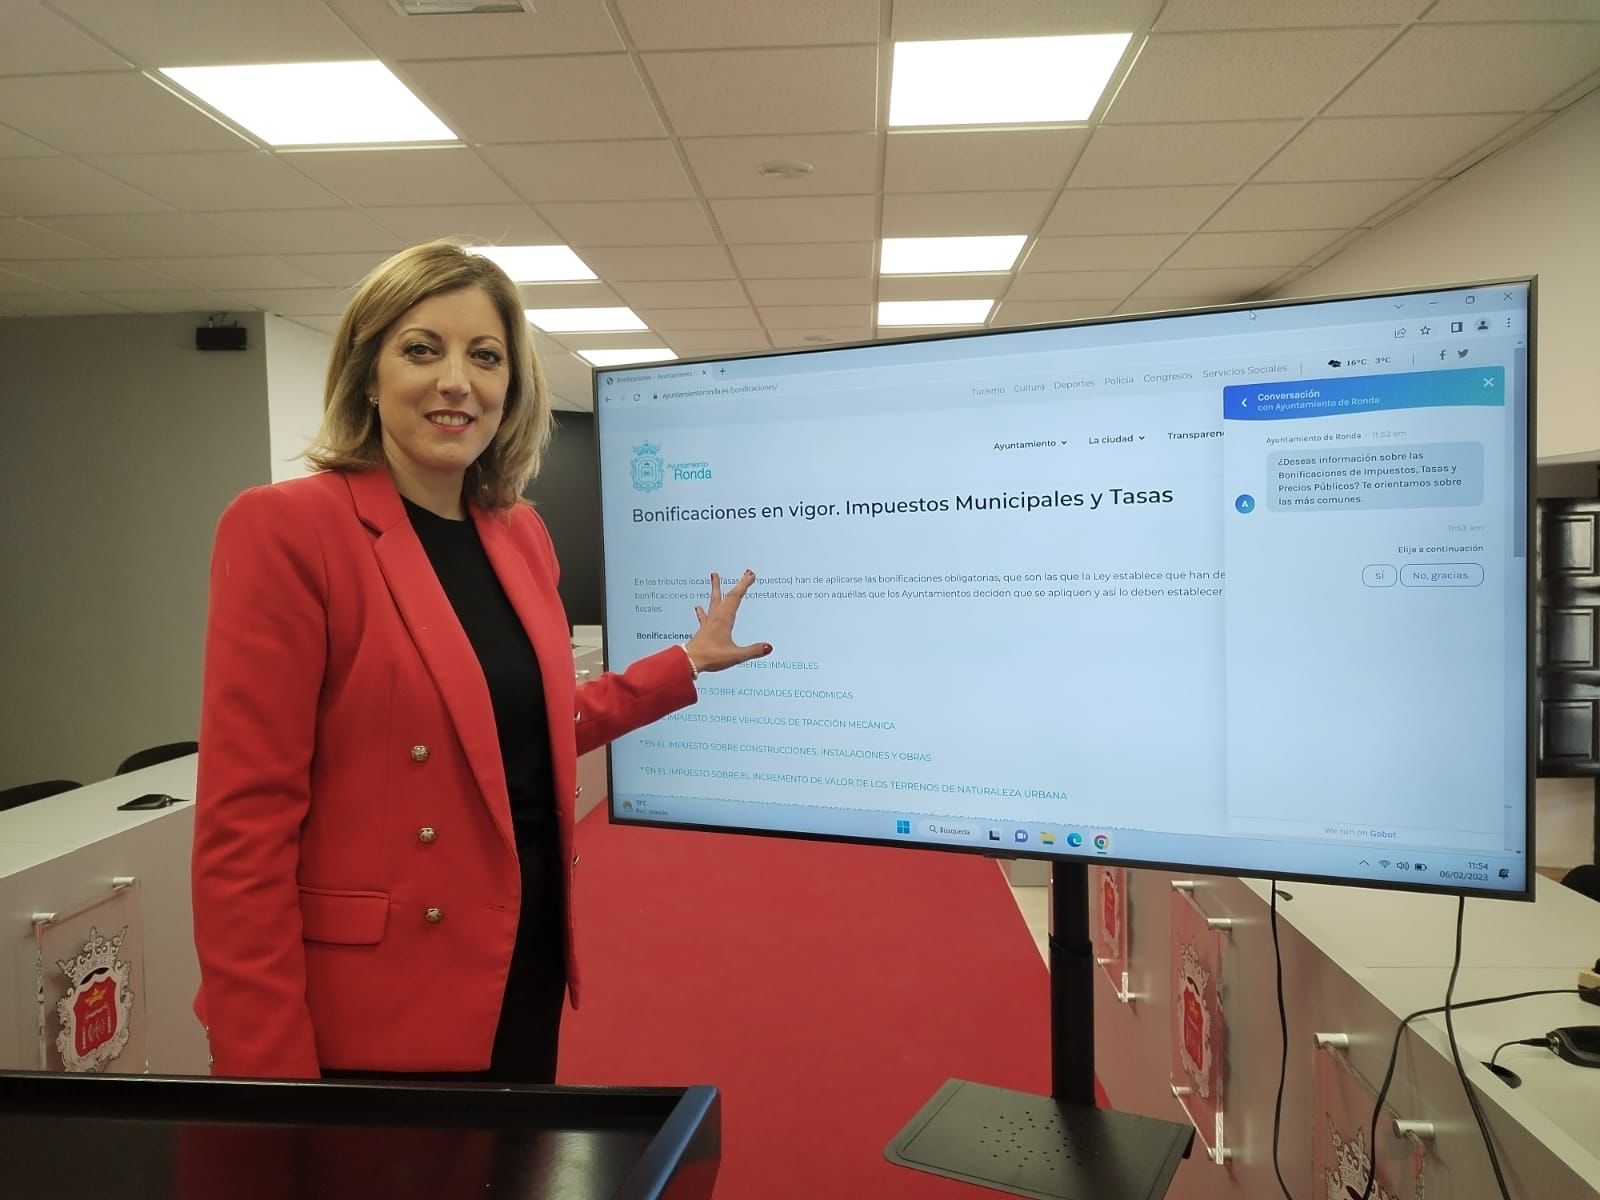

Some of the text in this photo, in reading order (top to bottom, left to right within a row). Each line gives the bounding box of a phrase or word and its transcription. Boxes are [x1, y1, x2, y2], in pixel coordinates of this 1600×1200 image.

[971, 363, 1288, 396] Turismo Cultura Deportes Policía Congresos Servicios Sociales
[1257, 389, 1320, 401] Conversación
[1257, 396, 1380, 413] con Ayuntamiento de Ronda
[993, 439, 1056, 452] Ayuntamiento
[1089, 434, 1134, 445] La ciudad
[1266, 435, 1322, 446] Ayuntamiento
[1277, 452, 1424, 467] ¿Deseas información sobre las
[674, 468, 712, 480] Ronda
[1278, 469, 1347, 479] Bonificaciones
[1364, 467, 1419, 477] Impuestos,
[1421, 465, 1449, 473] Tasas
[1451, 466, 1457, 474] y
[1278, 478, 1462, 492] Precios Públicos? Te orientamos sobre
[632, 487, 1174, 523] Bonificaciones en vigor. Impuestos Municipales y Tasas
[1278, 496, 1364, 506] las más comunes.
[1398, 545, 1417, 555] Elija
[1425, 544, 1484, 553] continuación
[634, 578, 645, 586] En
[645, 577, 657, 585] los
[658, 577, 688, 585] tributos
[689, 577, 713, 585] locale
[795, 576, 811, 584] han
[812, 576, 824, 584] de
[825, 575, 863, 586] aplicarse
[865, 575, 877, 583] las
[878, 574, 943, 583] bonificaciones
[944, 573, 1001, 584] obligatorias,
[1003, 574, 1022, 583] que
[1024, 573, 1042, 582] son
[1044, 572, 1058, 581] las
[1060, 573, 1080, 582] que
[1081, 572, 1091, 580] la
[1093, 572, 1111, 583] Ley
[1113, 571, 1163, 580] establece
[1165, 572, 1187, 582] que
[1189, 571, 1210, 580] han
[1413, 571, 1471, 582] No, gracias.
[634, 591, 689, 600] bonificaciones
[796, 591, 813, 600] que
[814, 591, 830, 599] son
[868, 591, 886, 600] que
[887, 590, 900, 598] los
[901, 589, 971, 600] Ayuntamientos
[973, 589, 1011, 598] deciden
[1013, 589, 1033, 599] que
[1048, 588, 1092, 599] apliquen
[1094, 589, 1100, 598] y
[1102, 588, 1117, 597] así
[1119, 588, 1129, 597] lo
[1130, 588, 1165, 597] deben
[1167, 587, 1223, 597] establecer
[769, 661, 819, 670] INMUEBLES
[709, 688, 735, 696] SOBRE
[737, 688, 793, 698] ACTIVIDADES
[667, 714, 708, 723] IMPUESTO
[709, 715, 736, 724] SOBRE
[788, 718, 800, 726] DE
[802, 717, 847, 728] TRACCIÓN
[848, 719, 896, 730] MECÁNICA
[644, 740, 655, 748] EN
[657, 740, 665, 748] EL
[668, 741, 709, 750] IMPUESTO
[710, 743, 738, 752] SOBRE
[740, 744, 819, 756] CONSTRUCCIONES,
[821, 748, 890, 759] INSTALACIONES
[899, 752, 932, 762] OBRAS
[645, 766, 1068, 800] EN EL IMPUESTO SOBRE EL INCREMENTO DE VALOR DE LOS TERRENOS DE NATURALEZA URBANA
[1324, 826, 1397, 839] We run on Gobot
[1468, 861, 1489, 871] 11:54
[1439, 870, 1489, 882] 06/02/2023
